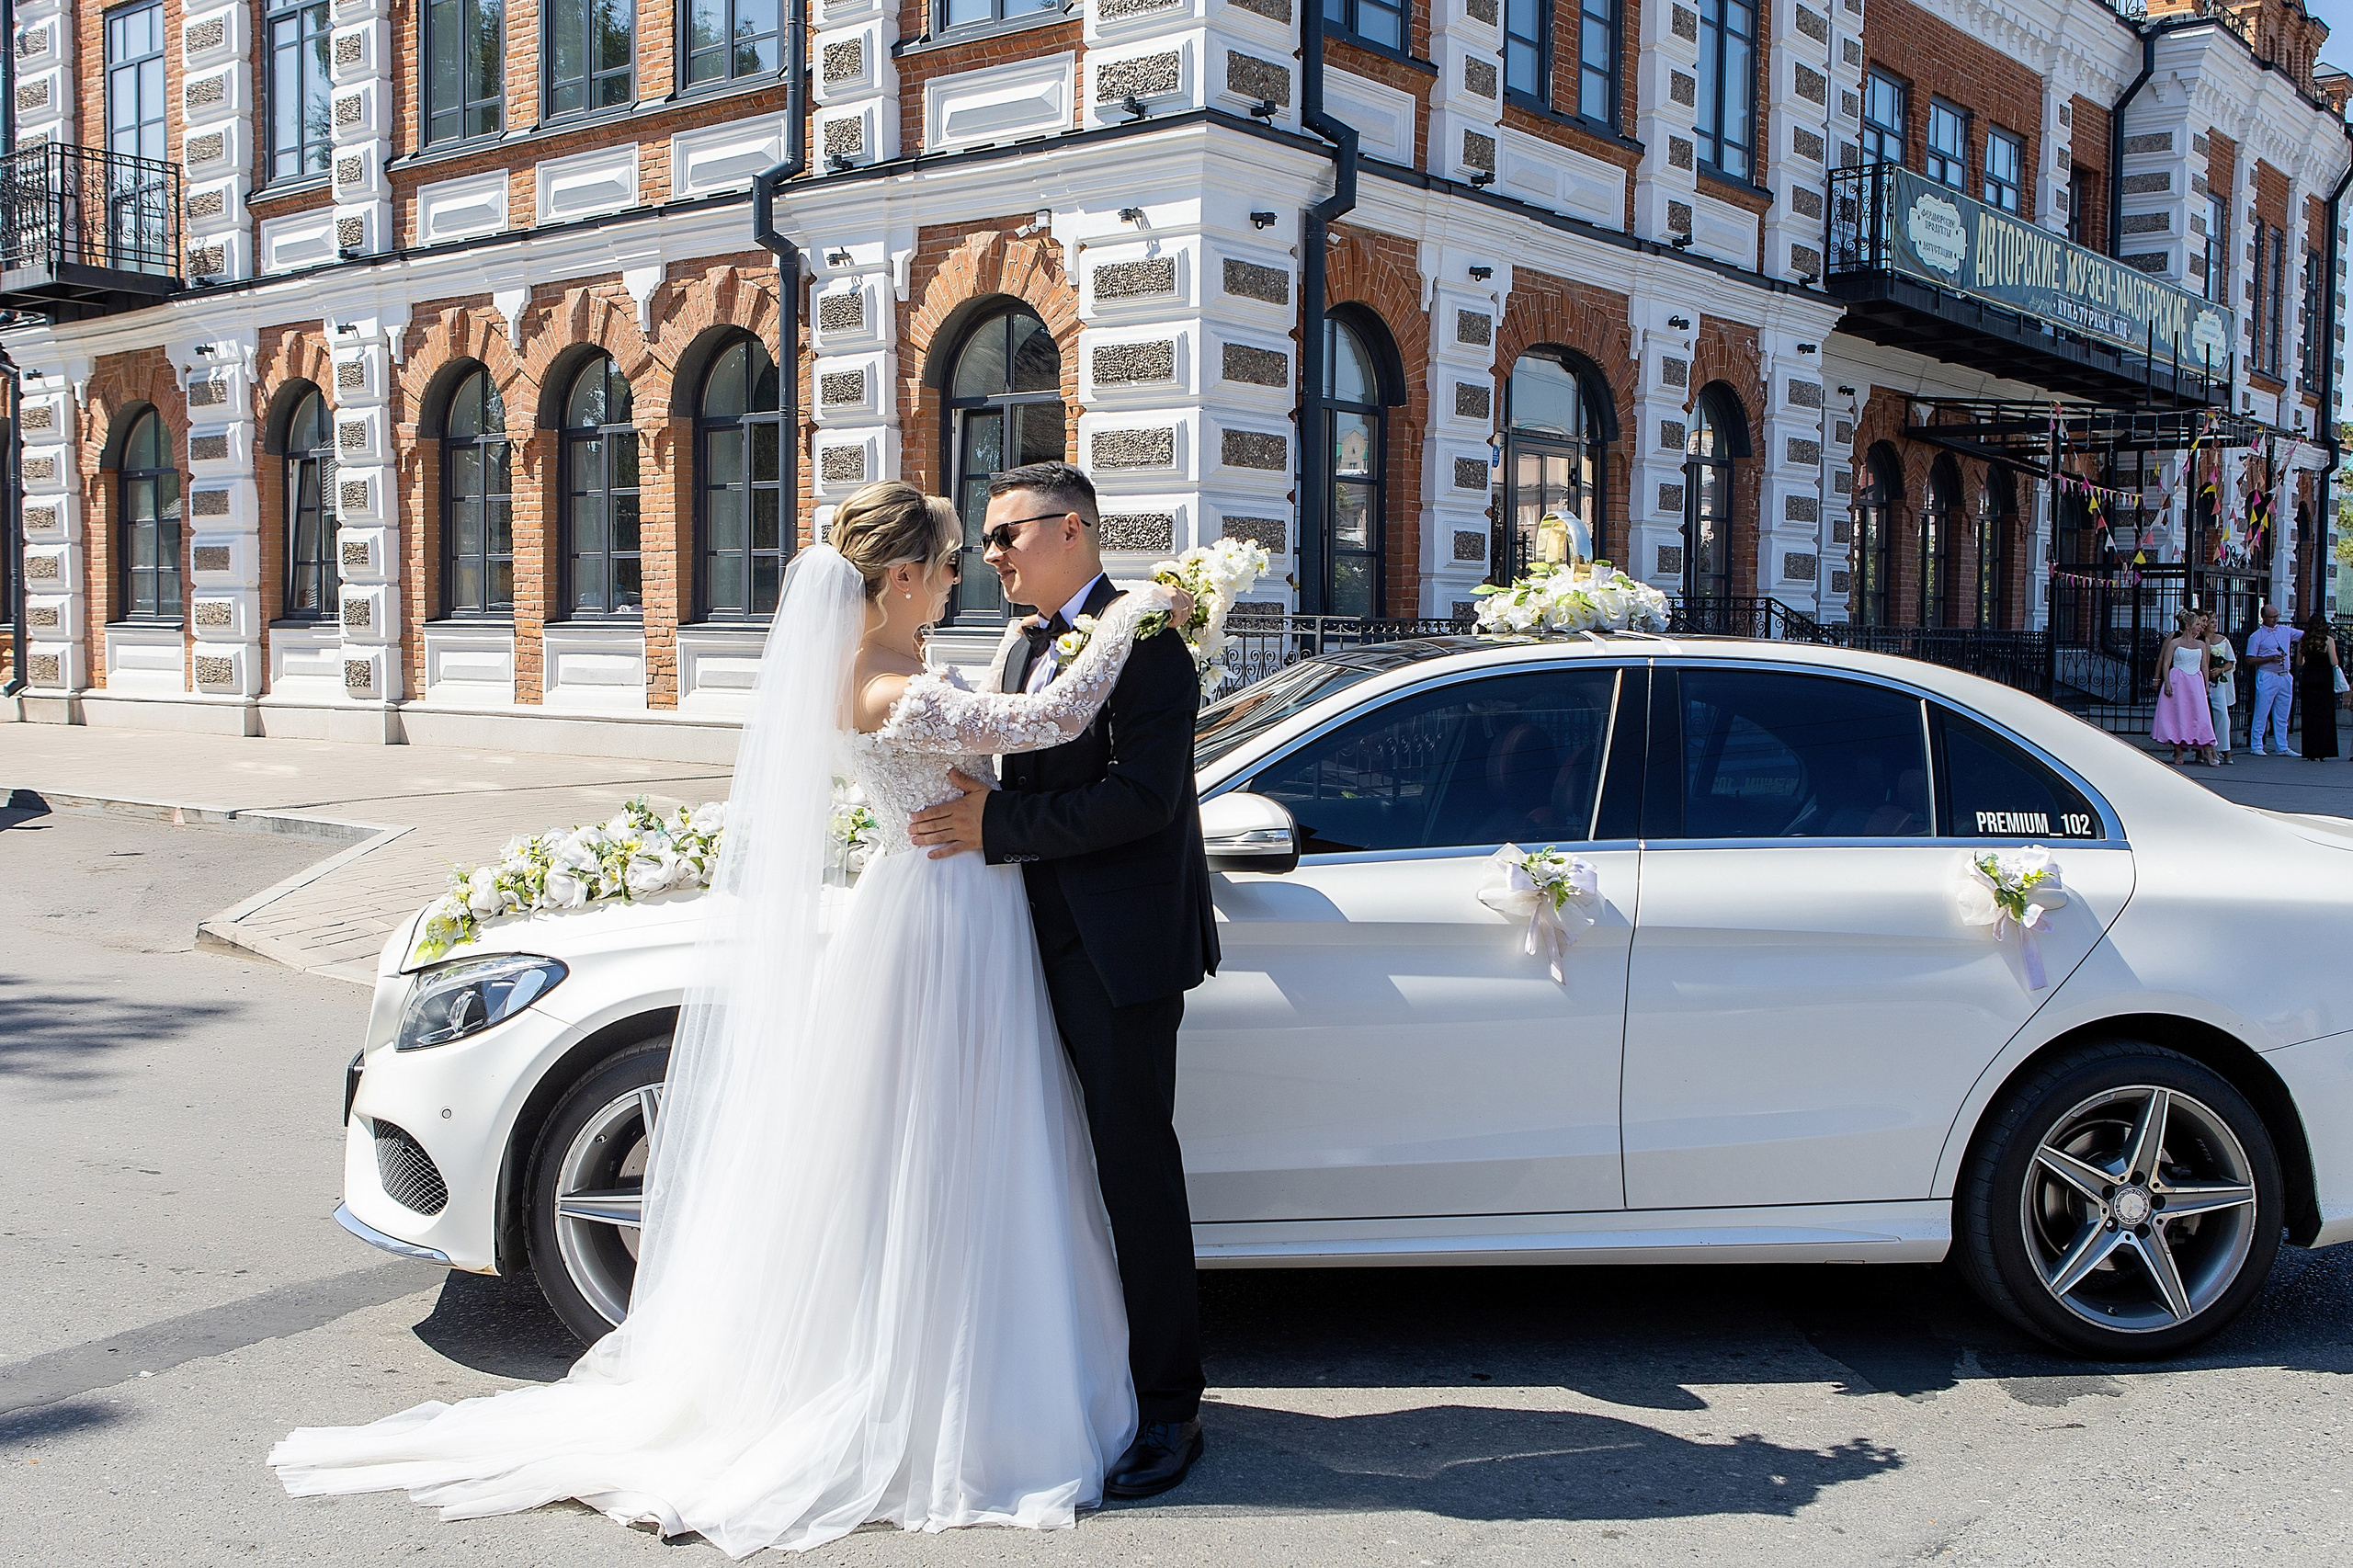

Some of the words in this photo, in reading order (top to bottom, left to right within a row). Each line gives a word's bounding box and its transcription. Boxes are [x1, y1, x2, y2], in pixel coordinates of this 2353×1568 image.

[1921, 209, 1955, 229] ФЕРМЕРСКИЕ
[1925, 220, 1951, 238] ПРОДУКТЫ
[1976, 212, 2060, 290] АВТОРСКИЕ
[2065, 249, 2188, 359] МУЗЕИ-МАСТЕРСКИЕ
[2057, 299, 2110, 332] КУЛЬТУРНЫЙ
[2114, 319, 2128, 340] КОД
[1975, 812, 2092, 836] PREMIUM_102
